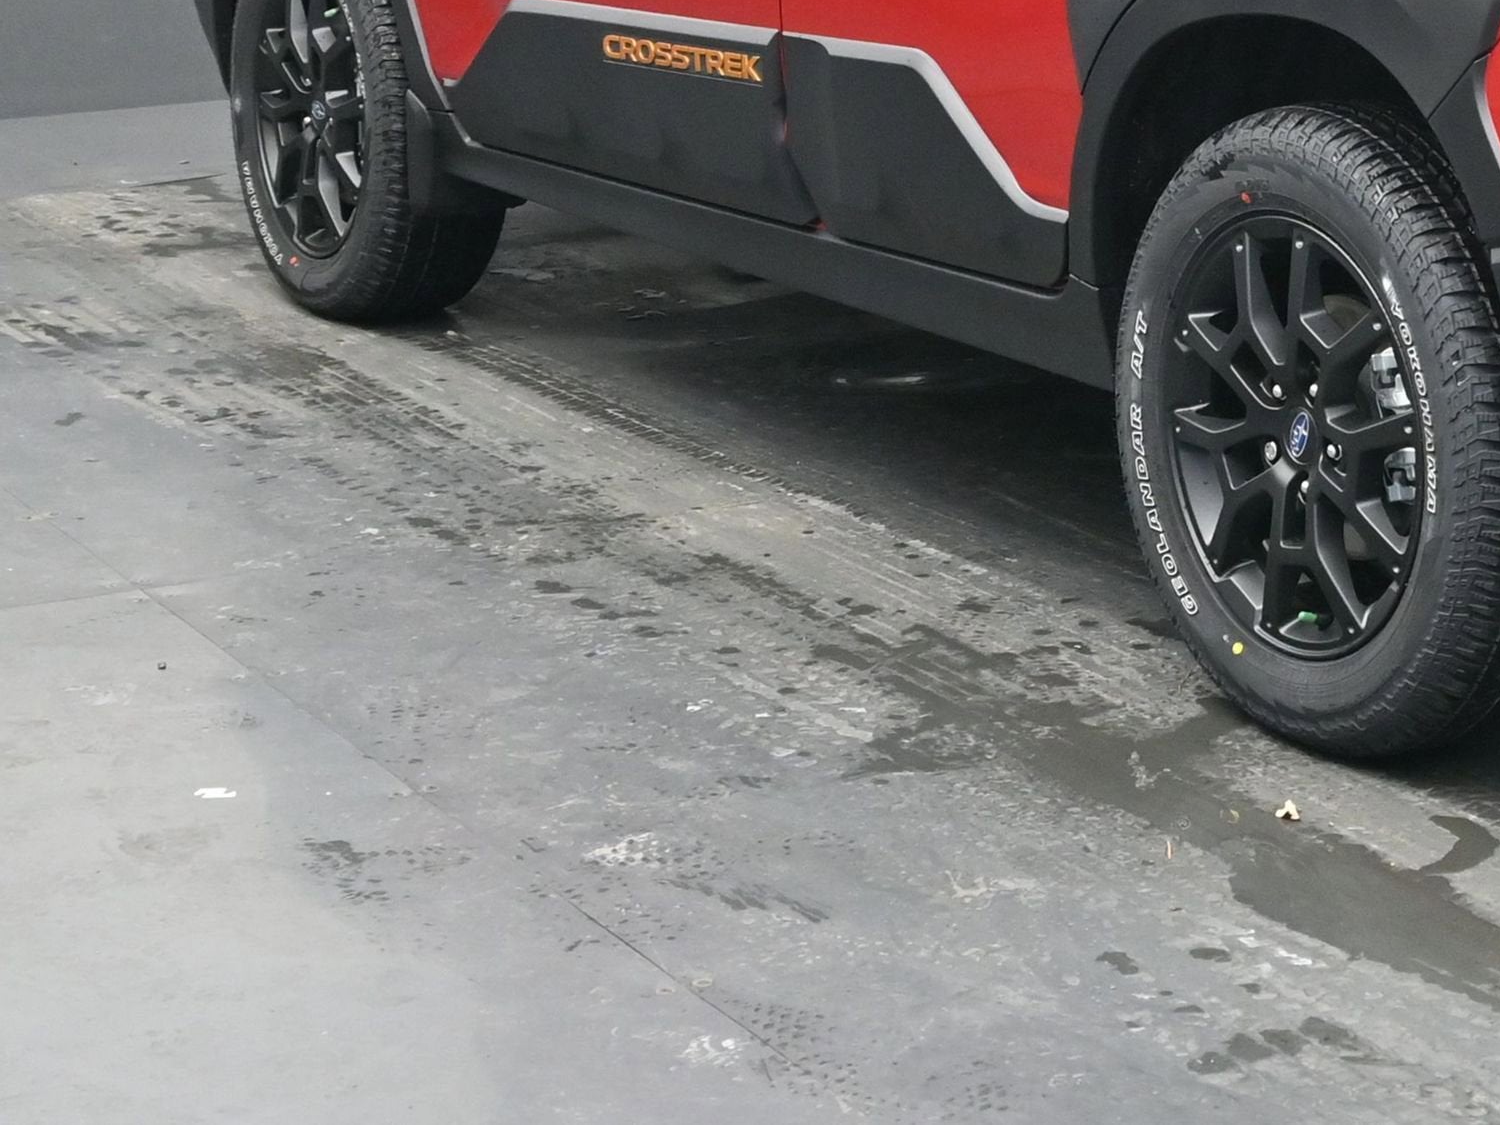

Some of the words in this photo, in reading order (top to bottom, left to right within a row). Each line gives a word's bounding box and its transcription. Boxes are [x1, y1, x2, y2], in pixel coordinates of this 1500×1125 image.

[602, 34, 762, 82] CROSSTREK
[1130, 309, 1148, 380] A/T
[1390, 300, 1437, 514] YOKOHAMA
[1129, 402, 1199, 616] GEOLANDAR
